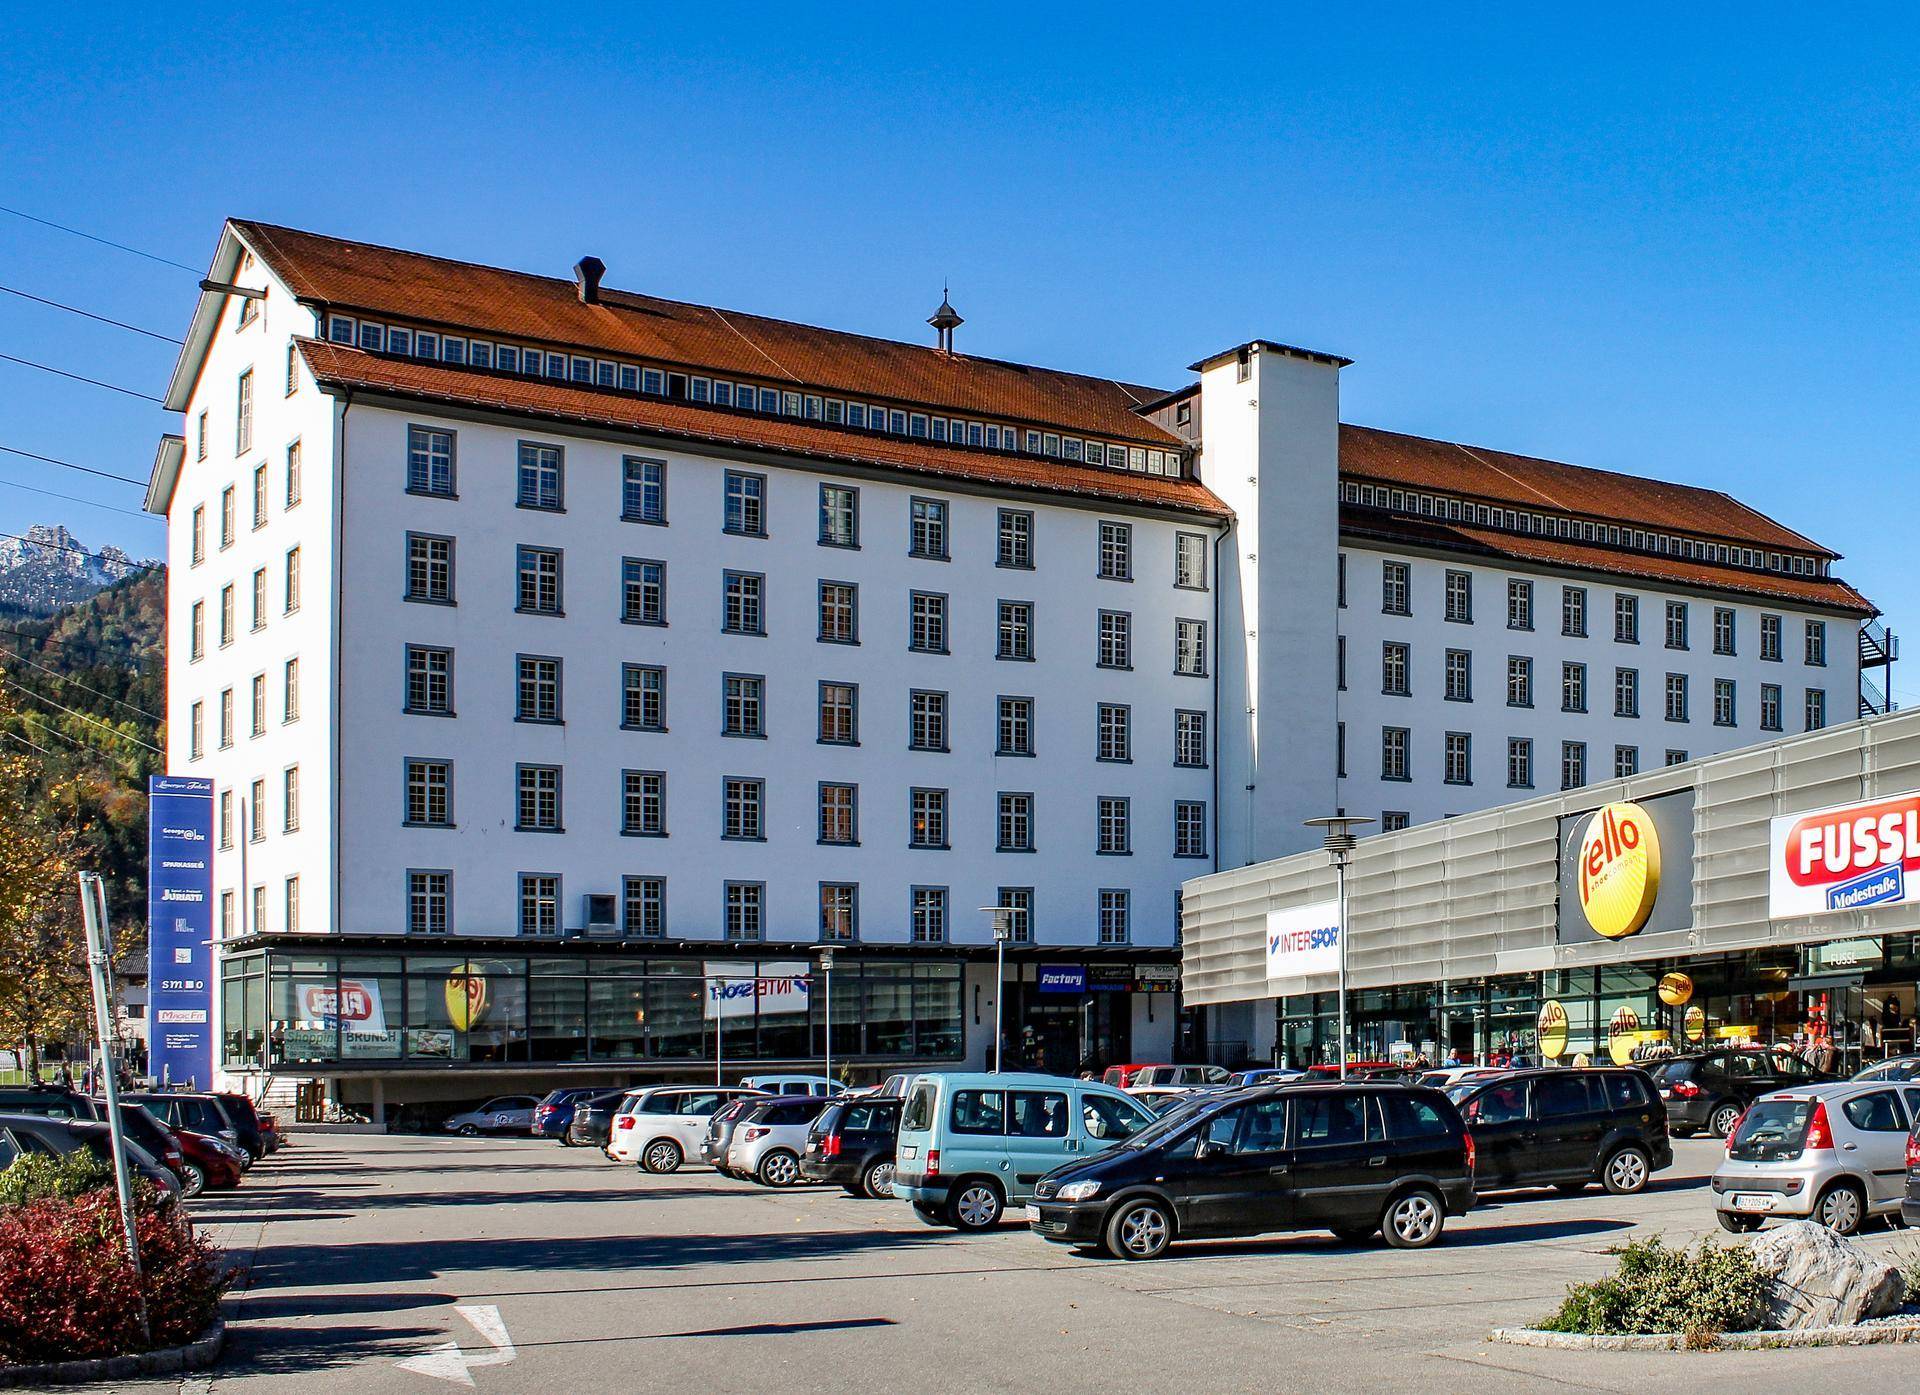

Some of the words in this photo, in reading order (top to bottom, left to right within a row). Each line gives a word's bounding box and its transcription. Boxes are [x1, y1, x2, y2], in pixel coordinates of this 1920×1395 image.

[1583, 807, 1640, 907] jello
[1799, 809, 1920, 875] FUSSL
[1833, 877, 1897, 909] Modestraße
[1281, 926, 1339, 954] INTERSPORT
[1042, 973, 1082, 986] Factory
[1538, 1002, 1562, 1044] jello
[1609, 1007, 1637, 1050] jello
